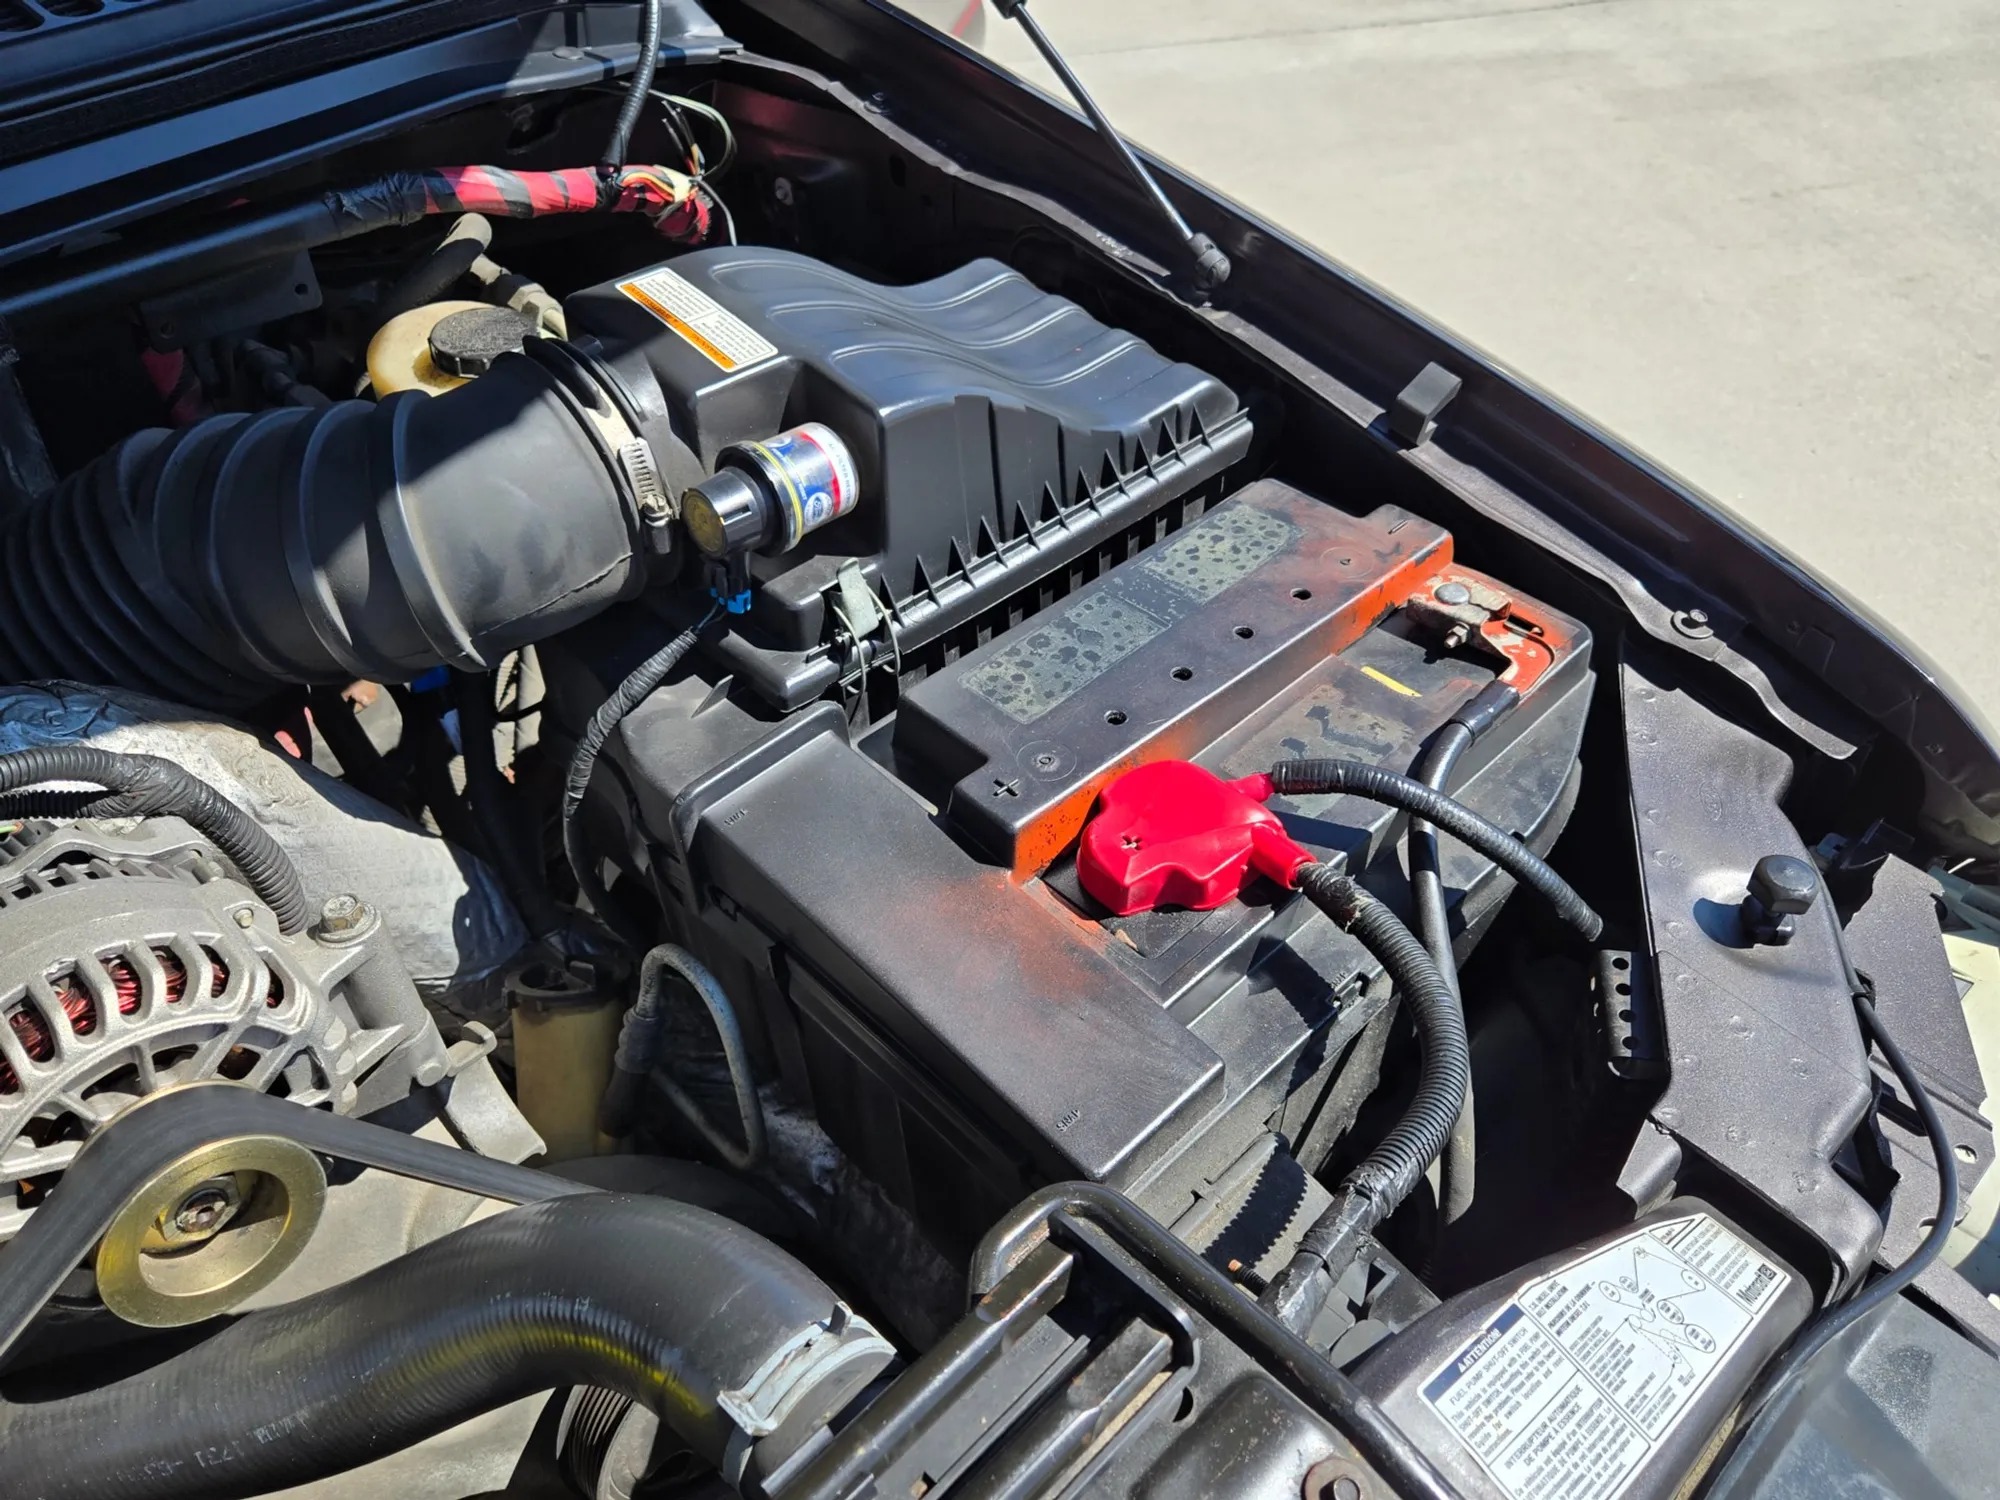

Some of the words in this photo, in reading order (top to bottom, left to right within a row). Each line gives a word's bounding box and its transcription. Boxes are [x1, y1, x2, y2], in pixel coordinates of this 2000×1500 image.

[1448, 1385, 1468, 1406] FUEL
[1464, 1368, 1485, 1390] PUMP
[1481, 1344, 1510, 1373] SHUT-OFF
[1506, 1325, 1528, 1348] SWITCH
[1461, 1390, 1483, 1412] vehicle
[1503, 1420, 1549, 1470] INTERRUPTEUR
[1545, 1383, 1583, 1424] AUTOMATIQUE
[1522, 1452, 1536, 1467] DE
[1531, 1430, 1555, 1457] POMPE
[1555, 1401, 1582, 1430] ESSENCE
[1523, 1463, 1560, 1500] UTOMATIQUE
